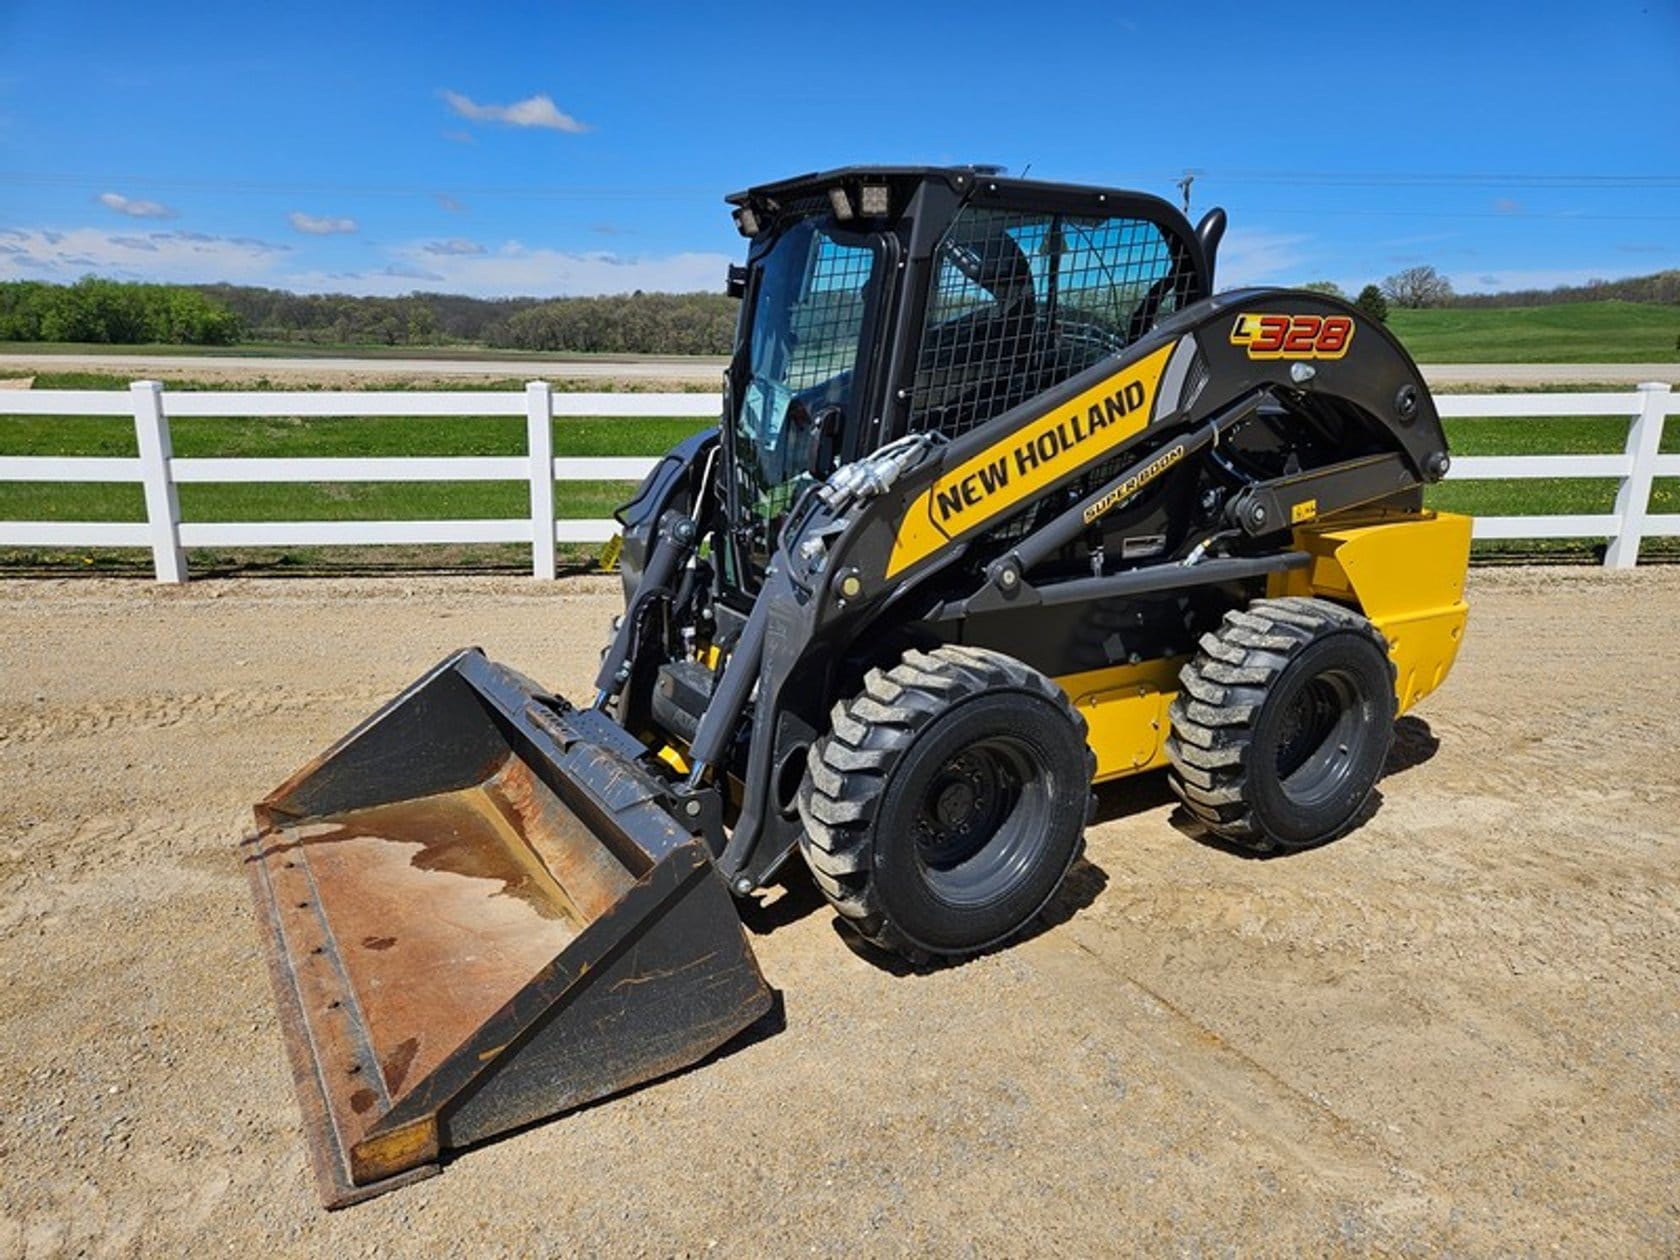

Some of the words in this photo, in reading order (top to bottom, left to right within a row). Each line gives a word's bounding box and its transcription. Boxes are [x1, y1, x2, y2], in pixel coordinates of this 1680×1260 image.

[1231, 313, 1354, 358] L328
[936, 456, 1009, 521] NEW
[1014, 379, 1146, 477] HOLLAND
[1084, 477, 1138, 524] SUPER
